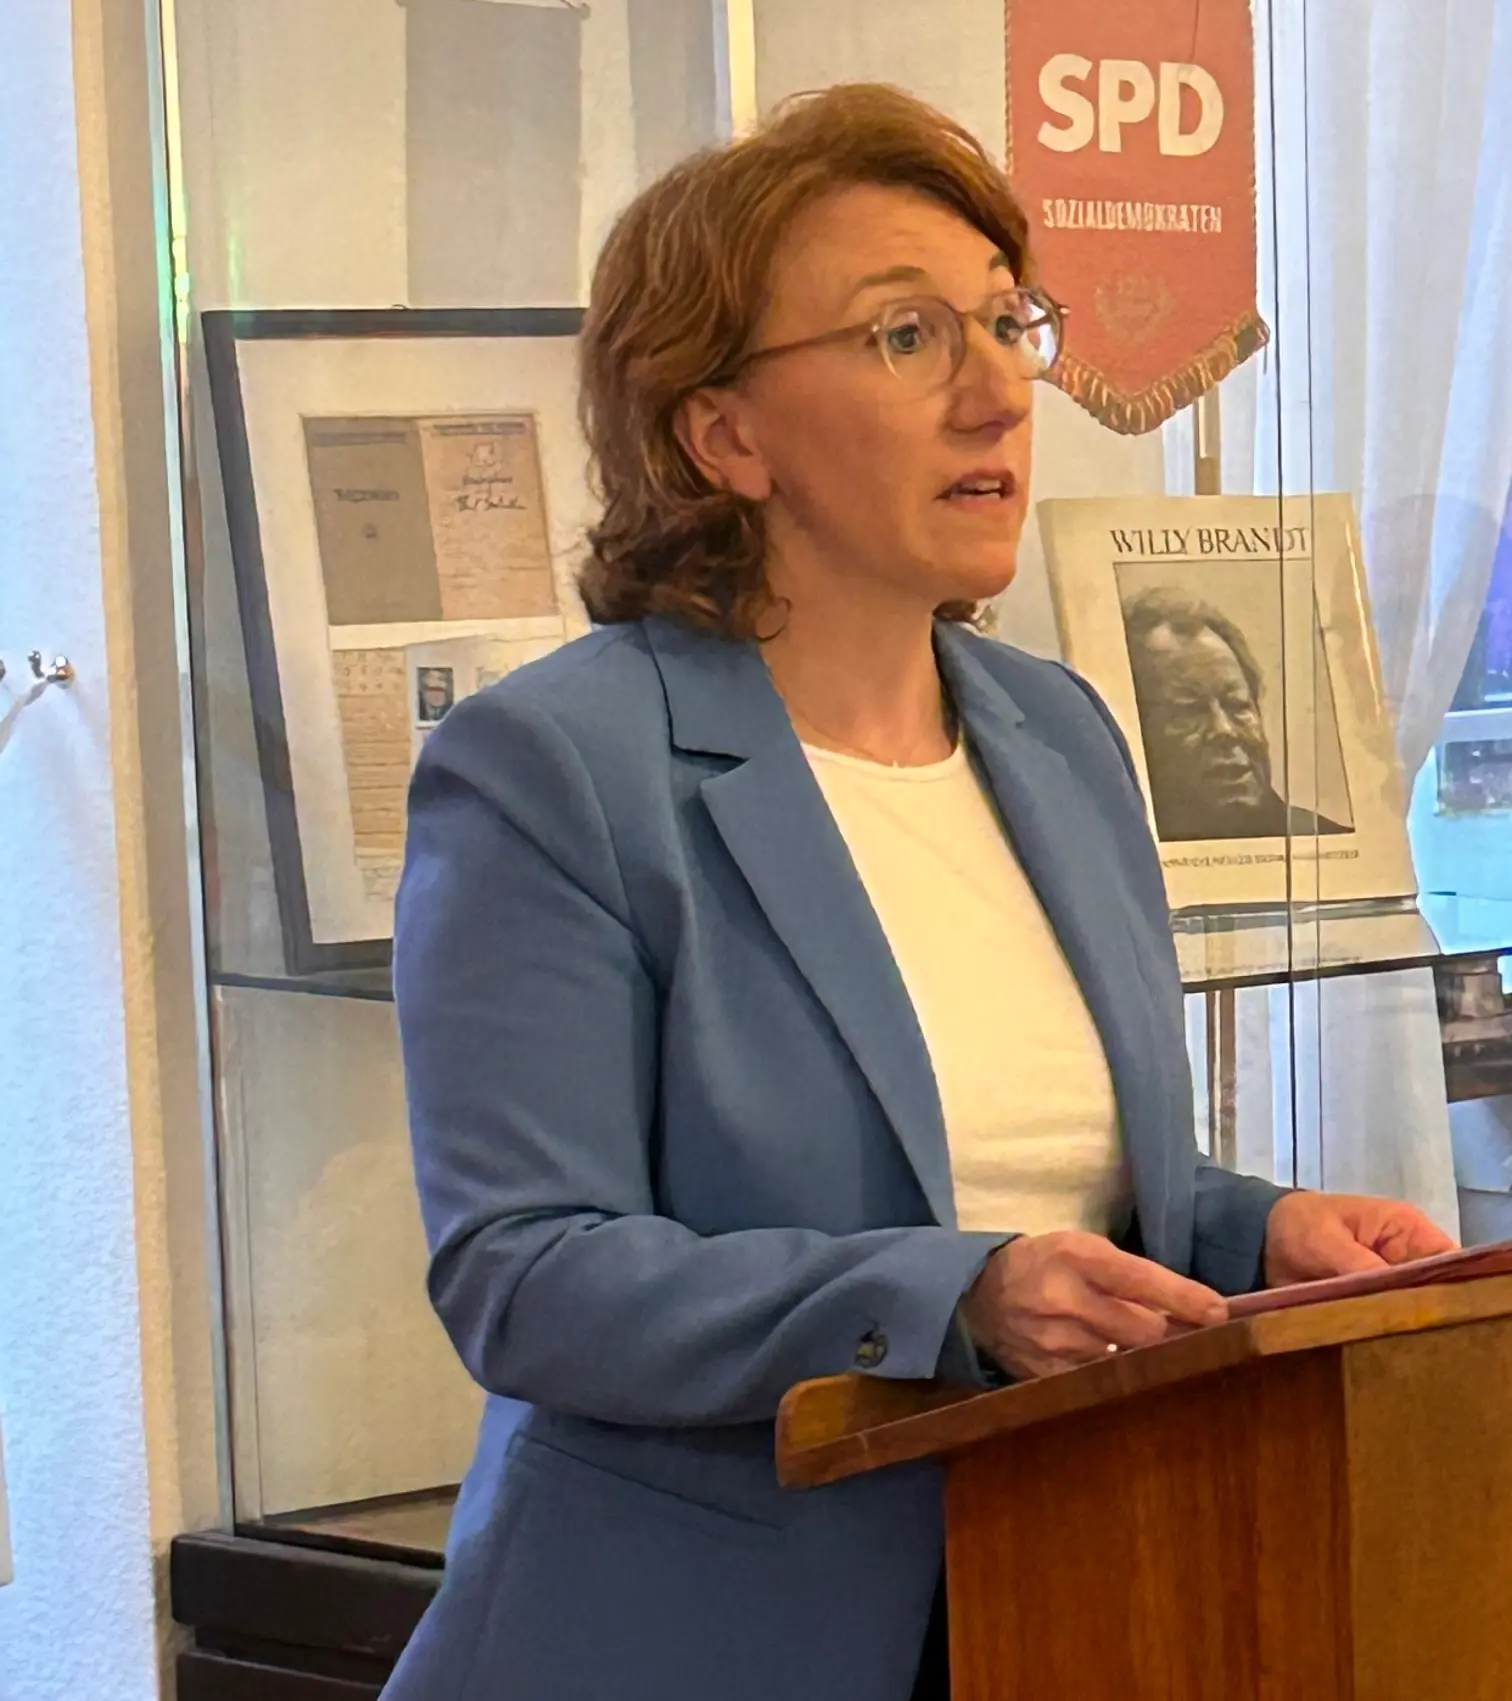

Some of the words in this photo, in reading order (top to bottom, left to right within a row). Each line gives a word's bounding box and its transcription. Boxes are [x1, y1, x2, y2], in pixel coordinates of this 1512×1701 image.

[1038, 53, 1224, 156] SPD
[1042, 199, 1222, 233] SOZIALDEMOKRATEN
[1109, 527, 1191, 555] WILLY
[1197, 526, 1309, 554] BRANDT
